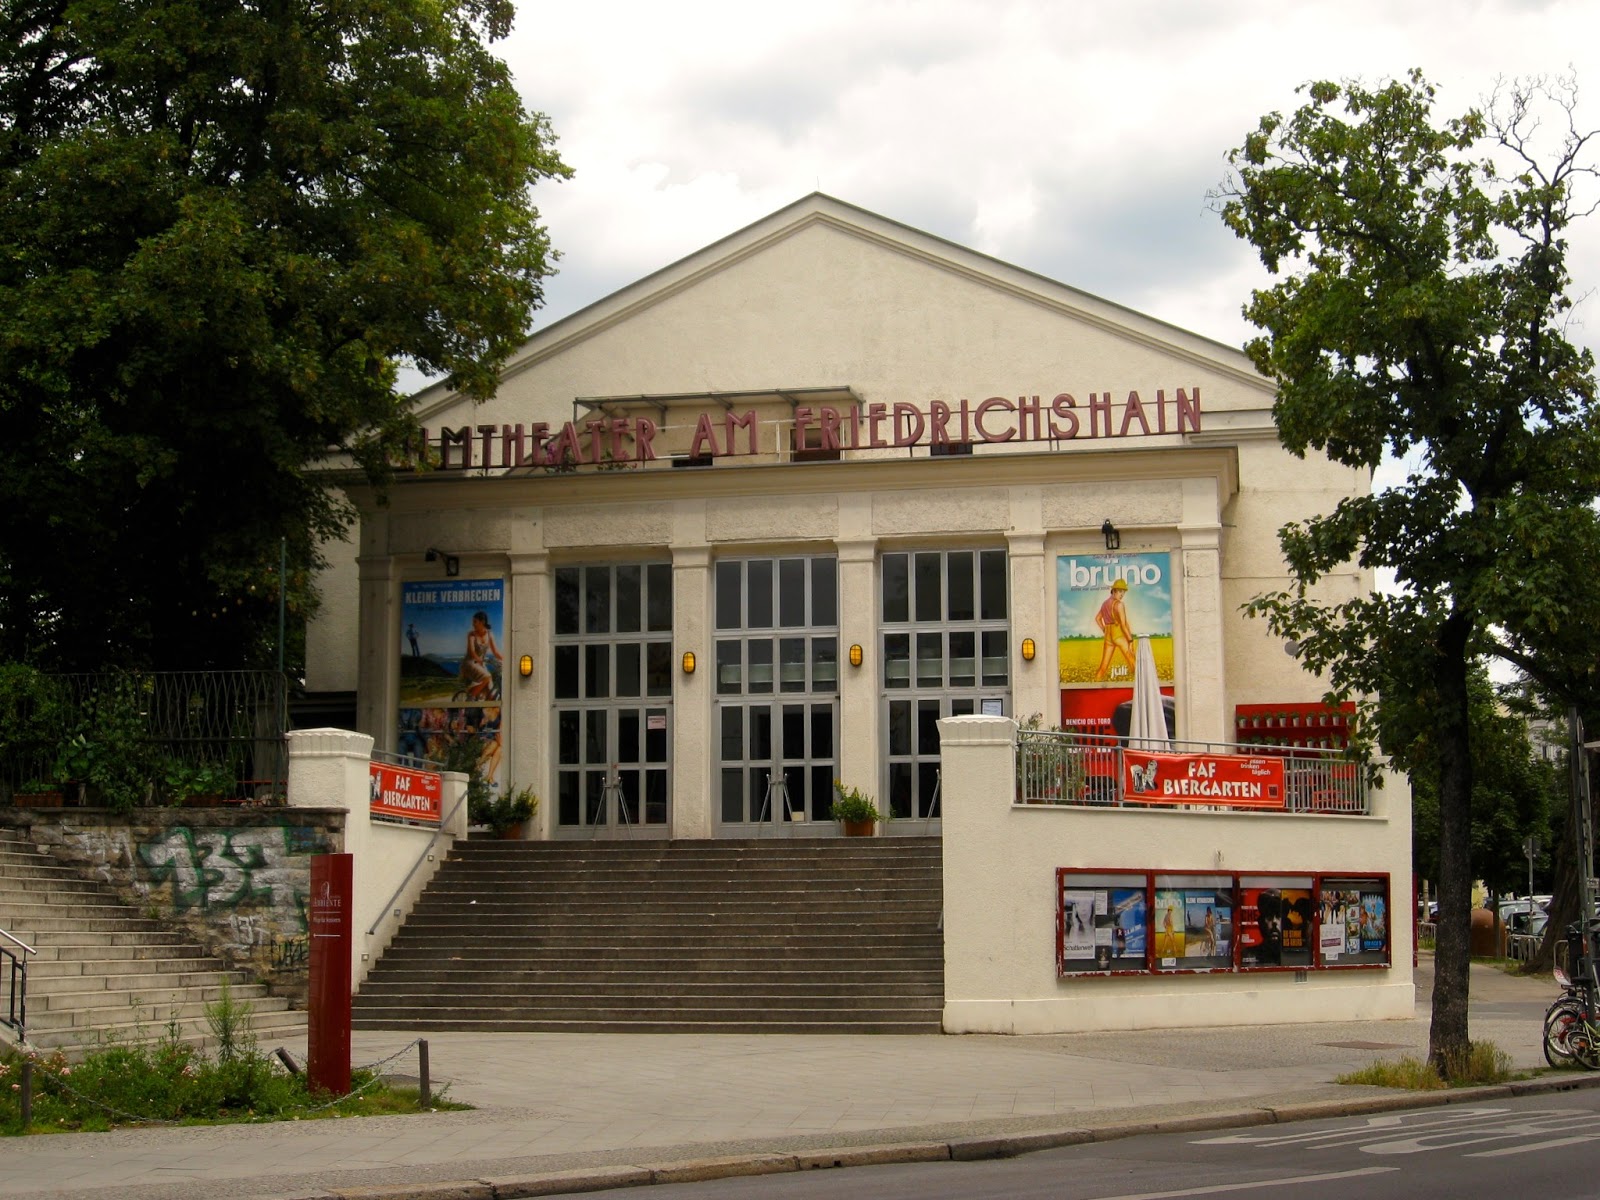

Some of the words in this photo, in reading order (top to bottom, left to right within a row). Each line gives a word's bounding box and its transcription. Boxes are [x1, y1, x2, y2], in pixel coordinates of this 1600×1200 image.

[690, 409, 758, 458] AM
[793, 386, 1201, 452] FRIEDRICHSHAIN
[1070, 558, 1162, 588] brüno
[405, 591, 437, 604] KLEINE
[440, 588, 501, 603] VERBRECHEN
[1065, 718, 1086, 726] BENICIO
[1097, 717, 1111, 725] TORO
[1187, 761, 1216, 778] FAF
[395, 774, 411, 791] FAF
[1163, 778, 1261, 798] BIERGARTEN
[383, 789, 430, 811] BIERGARTEN
